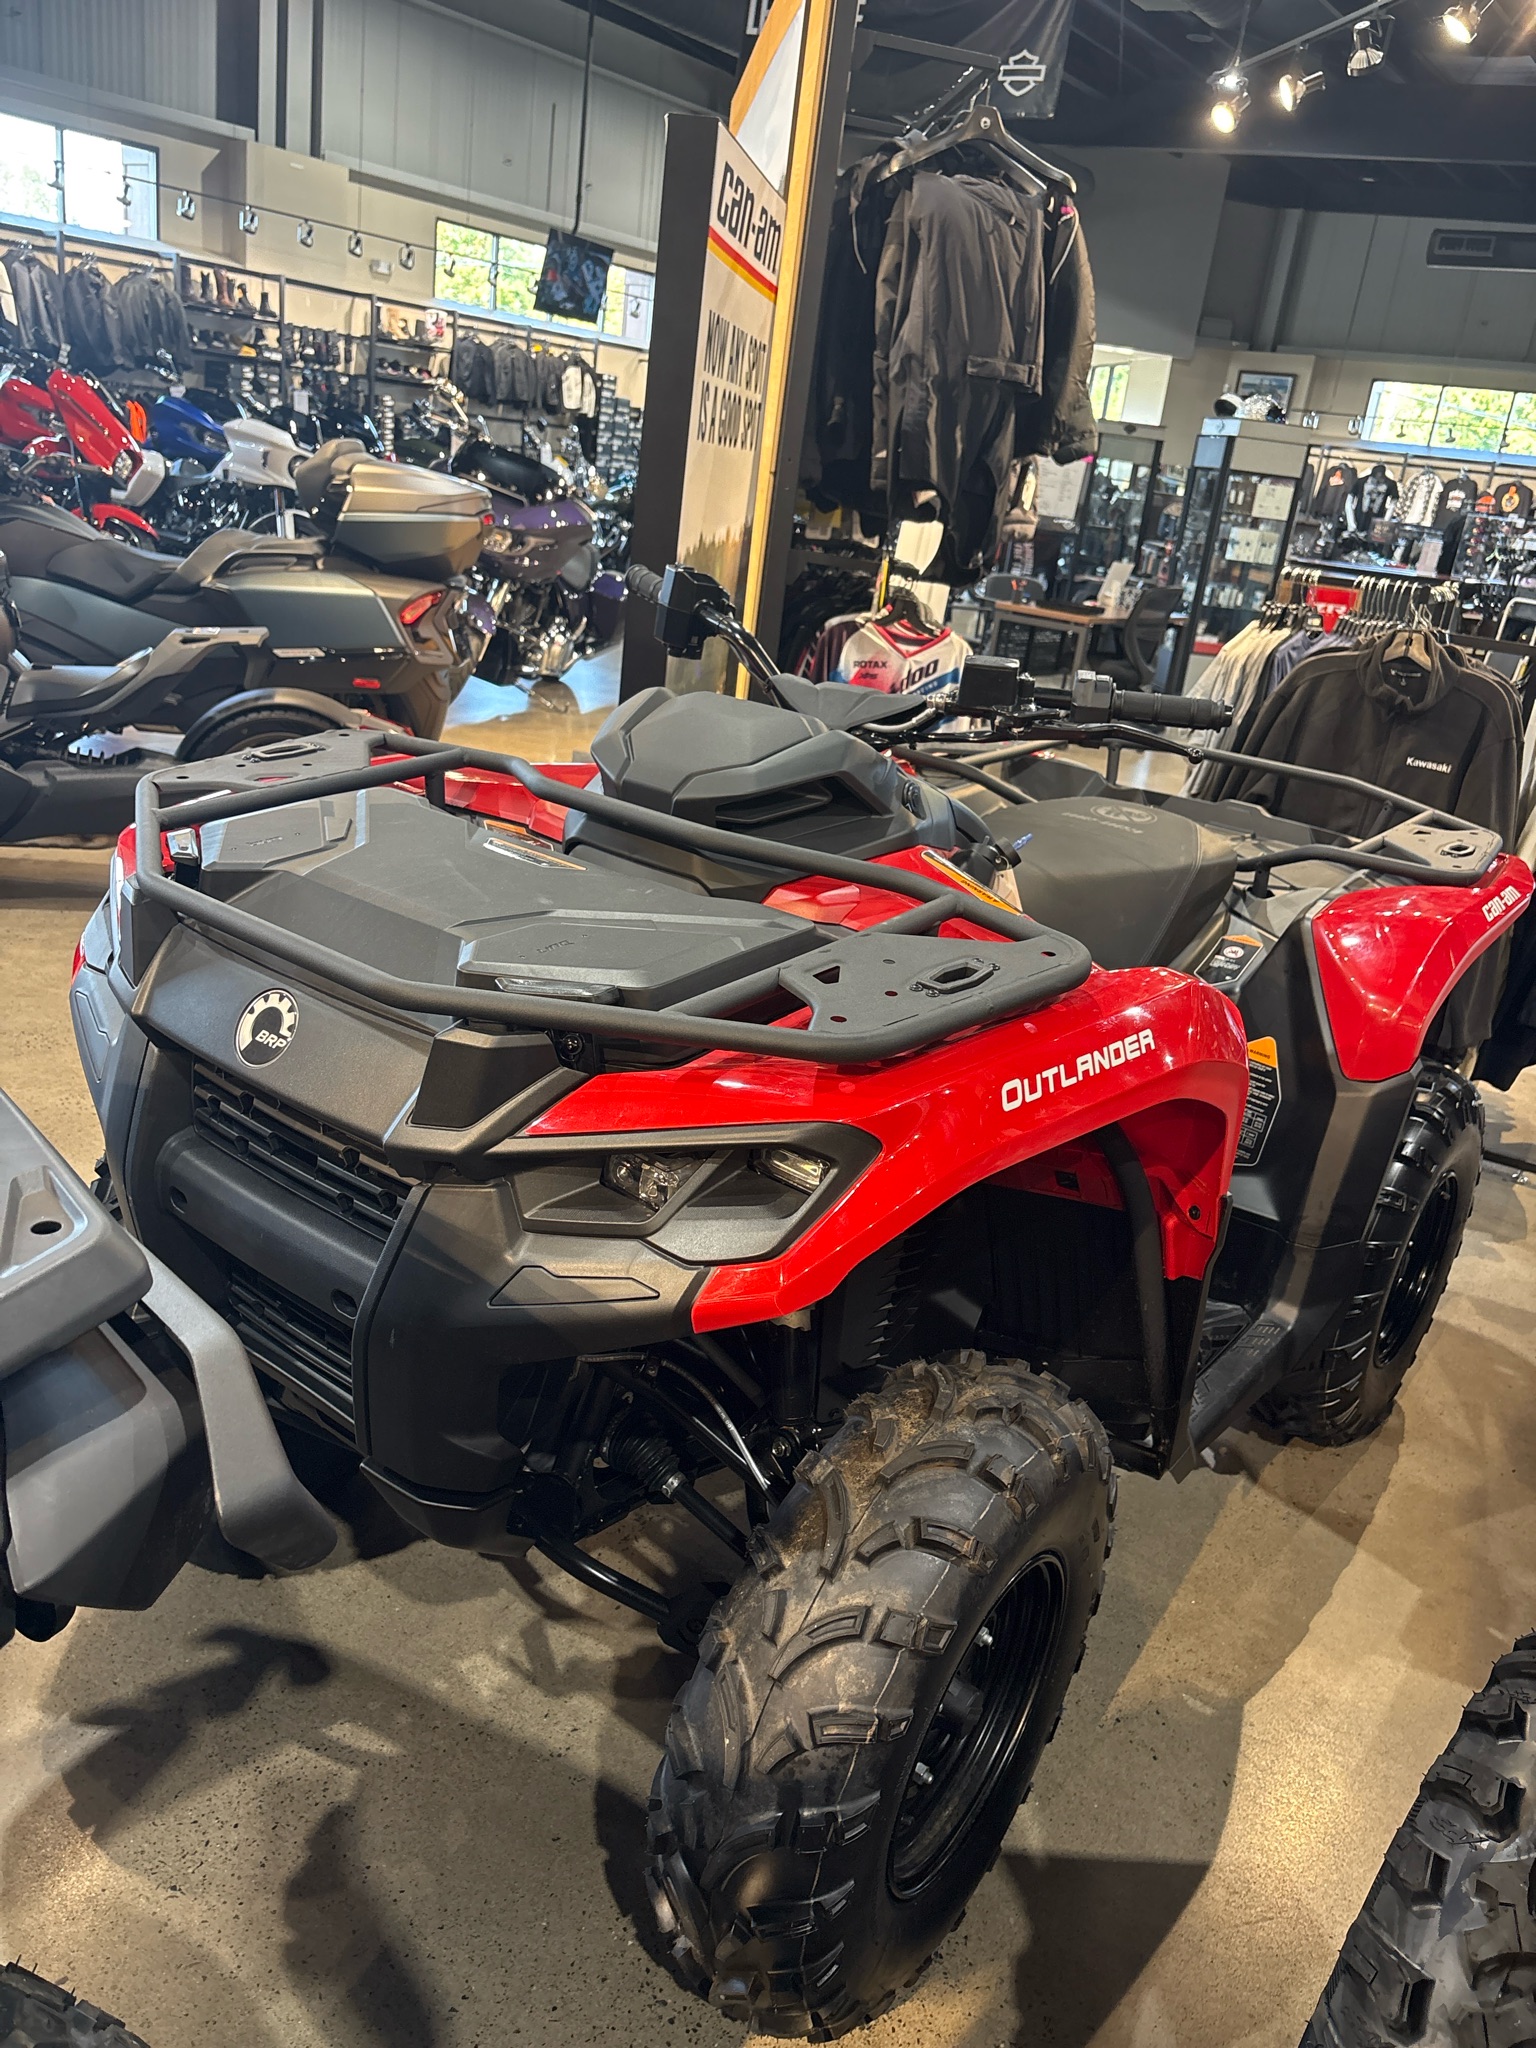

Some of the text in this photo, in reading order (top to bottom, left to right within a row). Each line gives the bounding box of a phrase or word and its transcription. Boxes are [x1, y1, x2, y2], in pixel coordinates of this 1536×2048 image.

[717, 161, 782, 274] can-am
[703, 309, 767, 395] NOW ANY SPOT
[697, 380, 710, 442] IS
[708, 386, 718, 444] A
[718, 388, 742, 448] GOOD
[853, 660, 888, 669] ROTAX
[1406, 756, 1452, 774] Kawasaki
[1481, 885, 1522, 922] can-am
[255, 1029, 287, 1049] BRP
[1001, 1028, 1155, 1112] OUTLANDER
